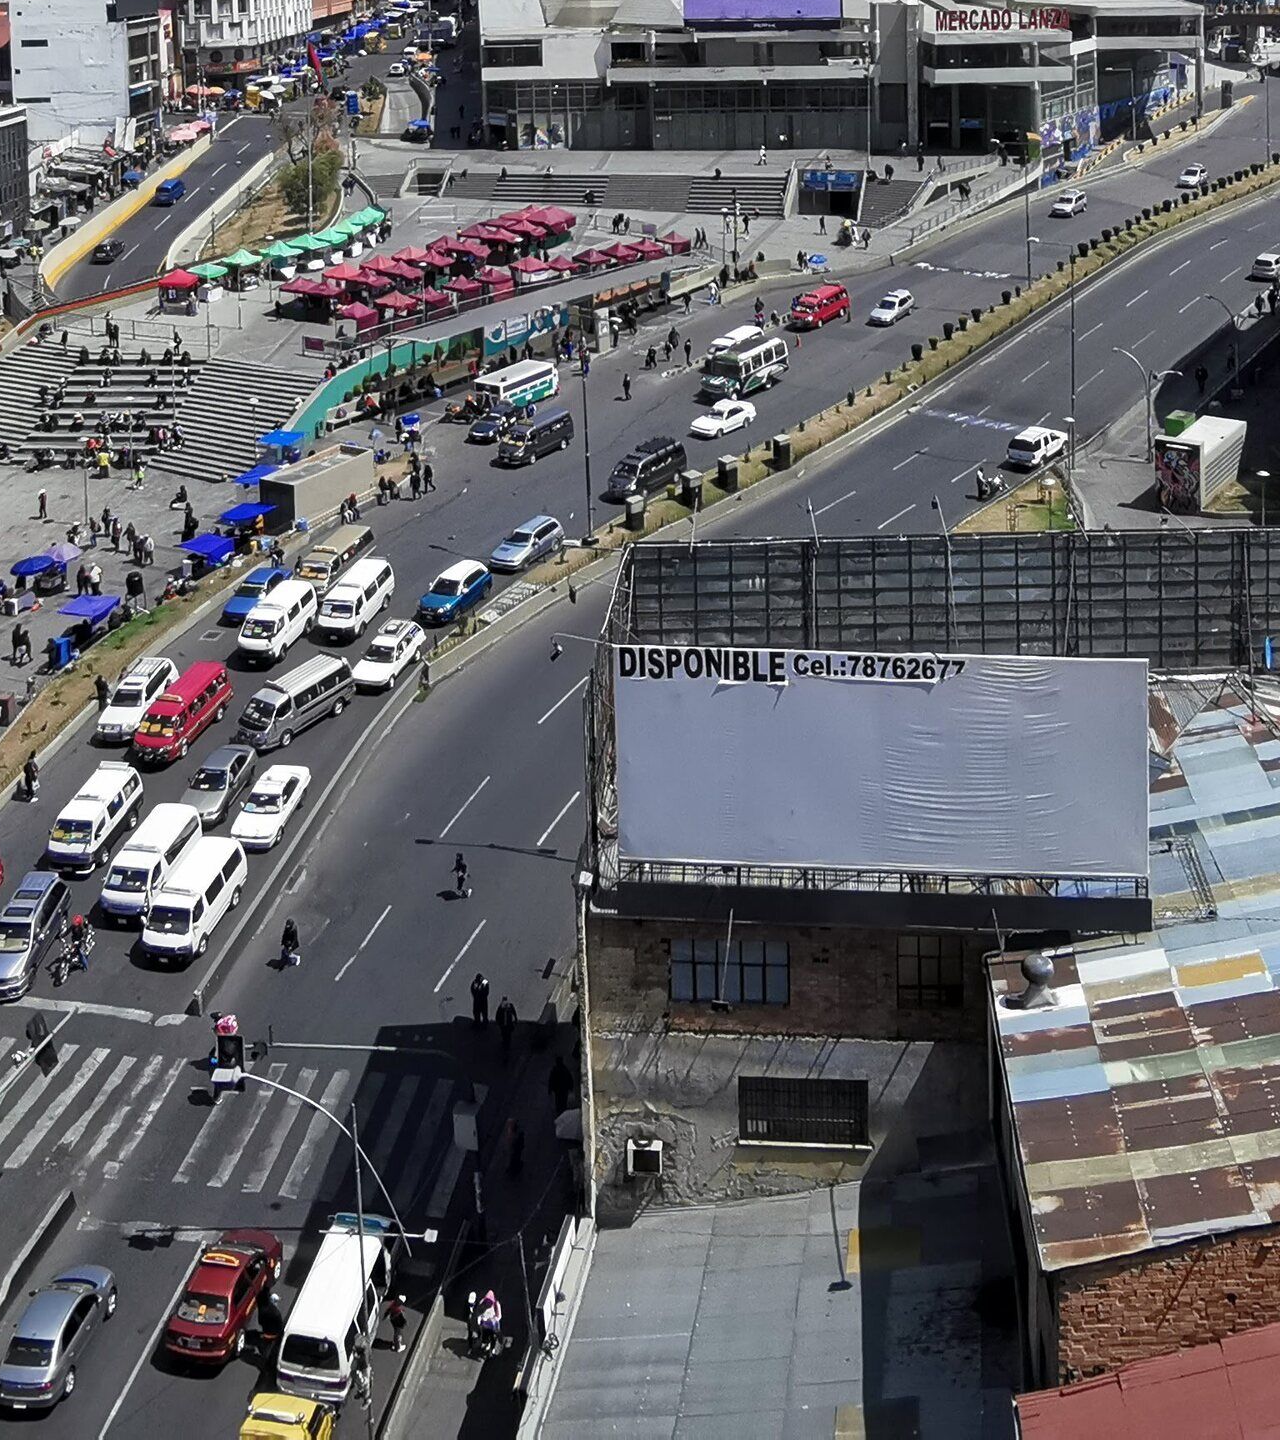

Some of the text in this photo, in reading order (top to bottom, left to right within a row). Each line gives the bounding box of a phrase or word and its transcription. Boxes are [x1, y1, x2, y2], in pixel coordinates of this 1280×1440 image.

[935, 8, 1070, 31] MERCADO LANZA
[619, 646, 786, 682] DISPONIBLE
